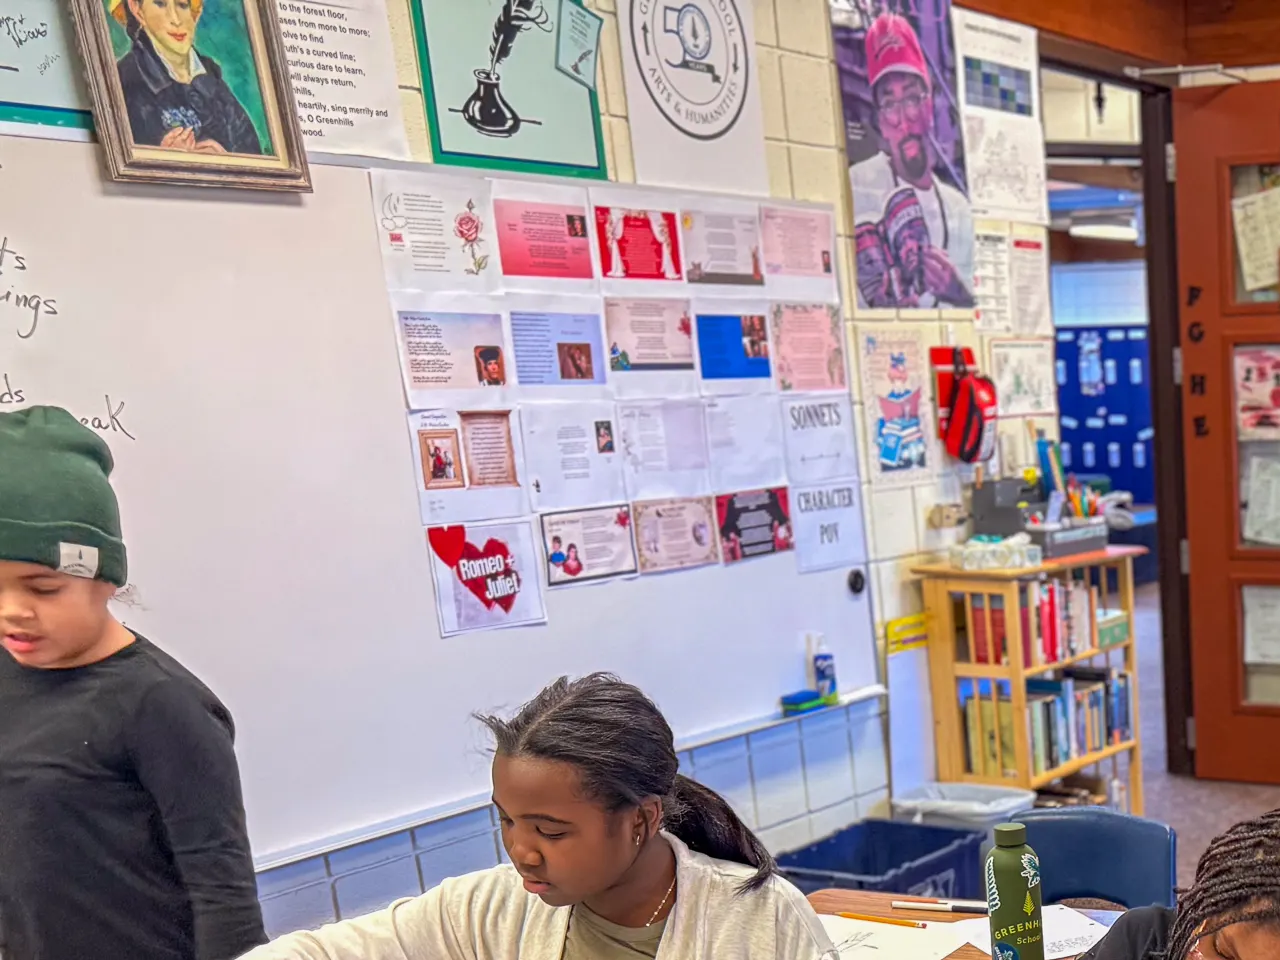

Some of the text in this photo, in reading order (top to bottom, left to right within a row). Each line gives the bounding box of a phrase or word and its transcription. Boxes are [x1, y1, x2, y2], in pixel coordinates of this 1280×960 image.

[279, 2, 348, 21] to the forest floor,
[279, 17, 371, 38] ases from more to more;
[282, 30, 324, 43] olve to find
[312, 48, 338, 59] curved
[340, 51, 356, 62] line;
[286, 59, 366, 77] curious dare to learn,
[303, 74, 330, 86] always
[331, 78, 357, 89] return,
[648, 66, 738, 126] ARTS & HUMANITIES
[297, 100, 389, 118] heartily, sing merrily and
[307, 114, 315, 123] O
[316, 115, 355, 127] Greenhills
[789, 402, 842, 430] SONNETS
[797, 487, 855, 513] CHARACTER
[819, 523, 839, 545] POV
[459, 554, 504, 581] Romeo
[486, 575, 520, 600] Juliet
